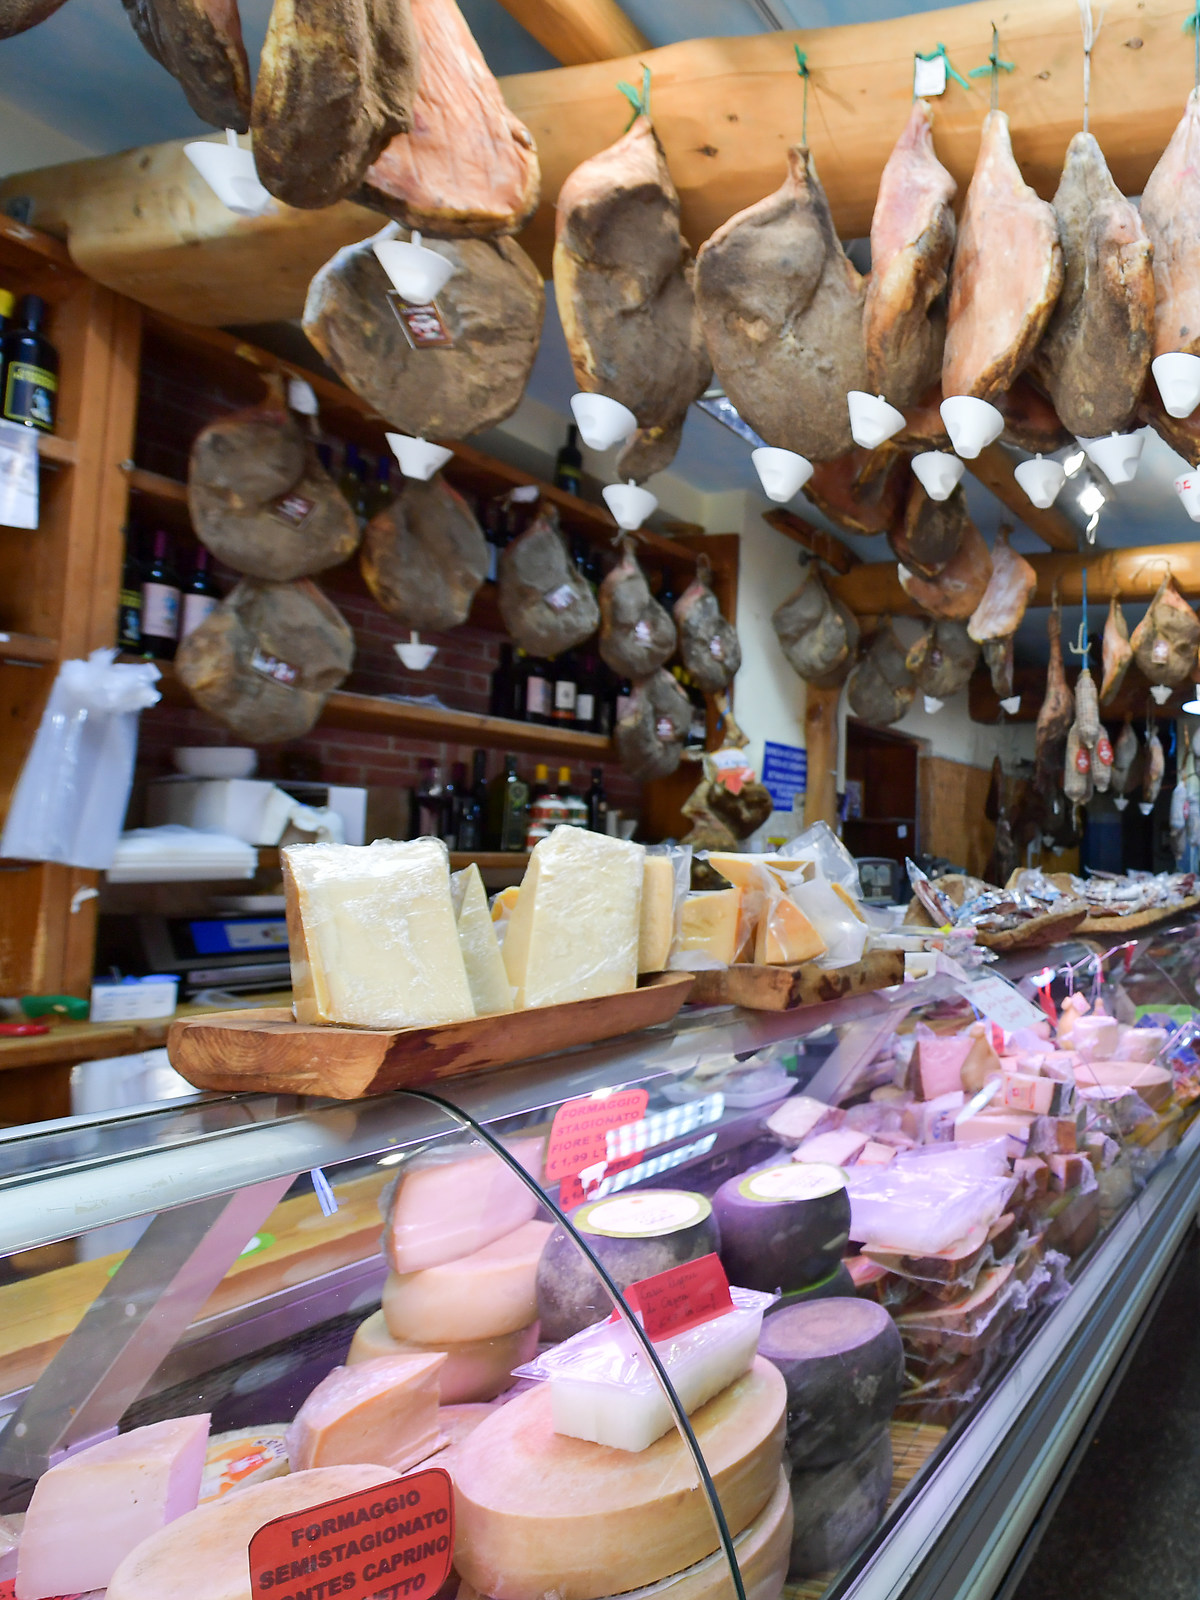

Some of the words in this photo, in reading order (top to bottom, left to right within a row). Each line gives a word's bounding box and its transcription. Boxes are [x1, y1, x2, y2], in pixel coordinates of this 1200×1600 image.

[556, 1111, 641, 1137] STAGIONATO
[560, 1096, 641, 1120] FORMAGGIO
[551, 1136, 590, 1153] FIORE
[291, 1489, 421, 1548] FORMAGGIO
[258, 1507, 448, 1591] SEMISTAGIONATO
[362, 1535, 449, 1582] CAPRINO
